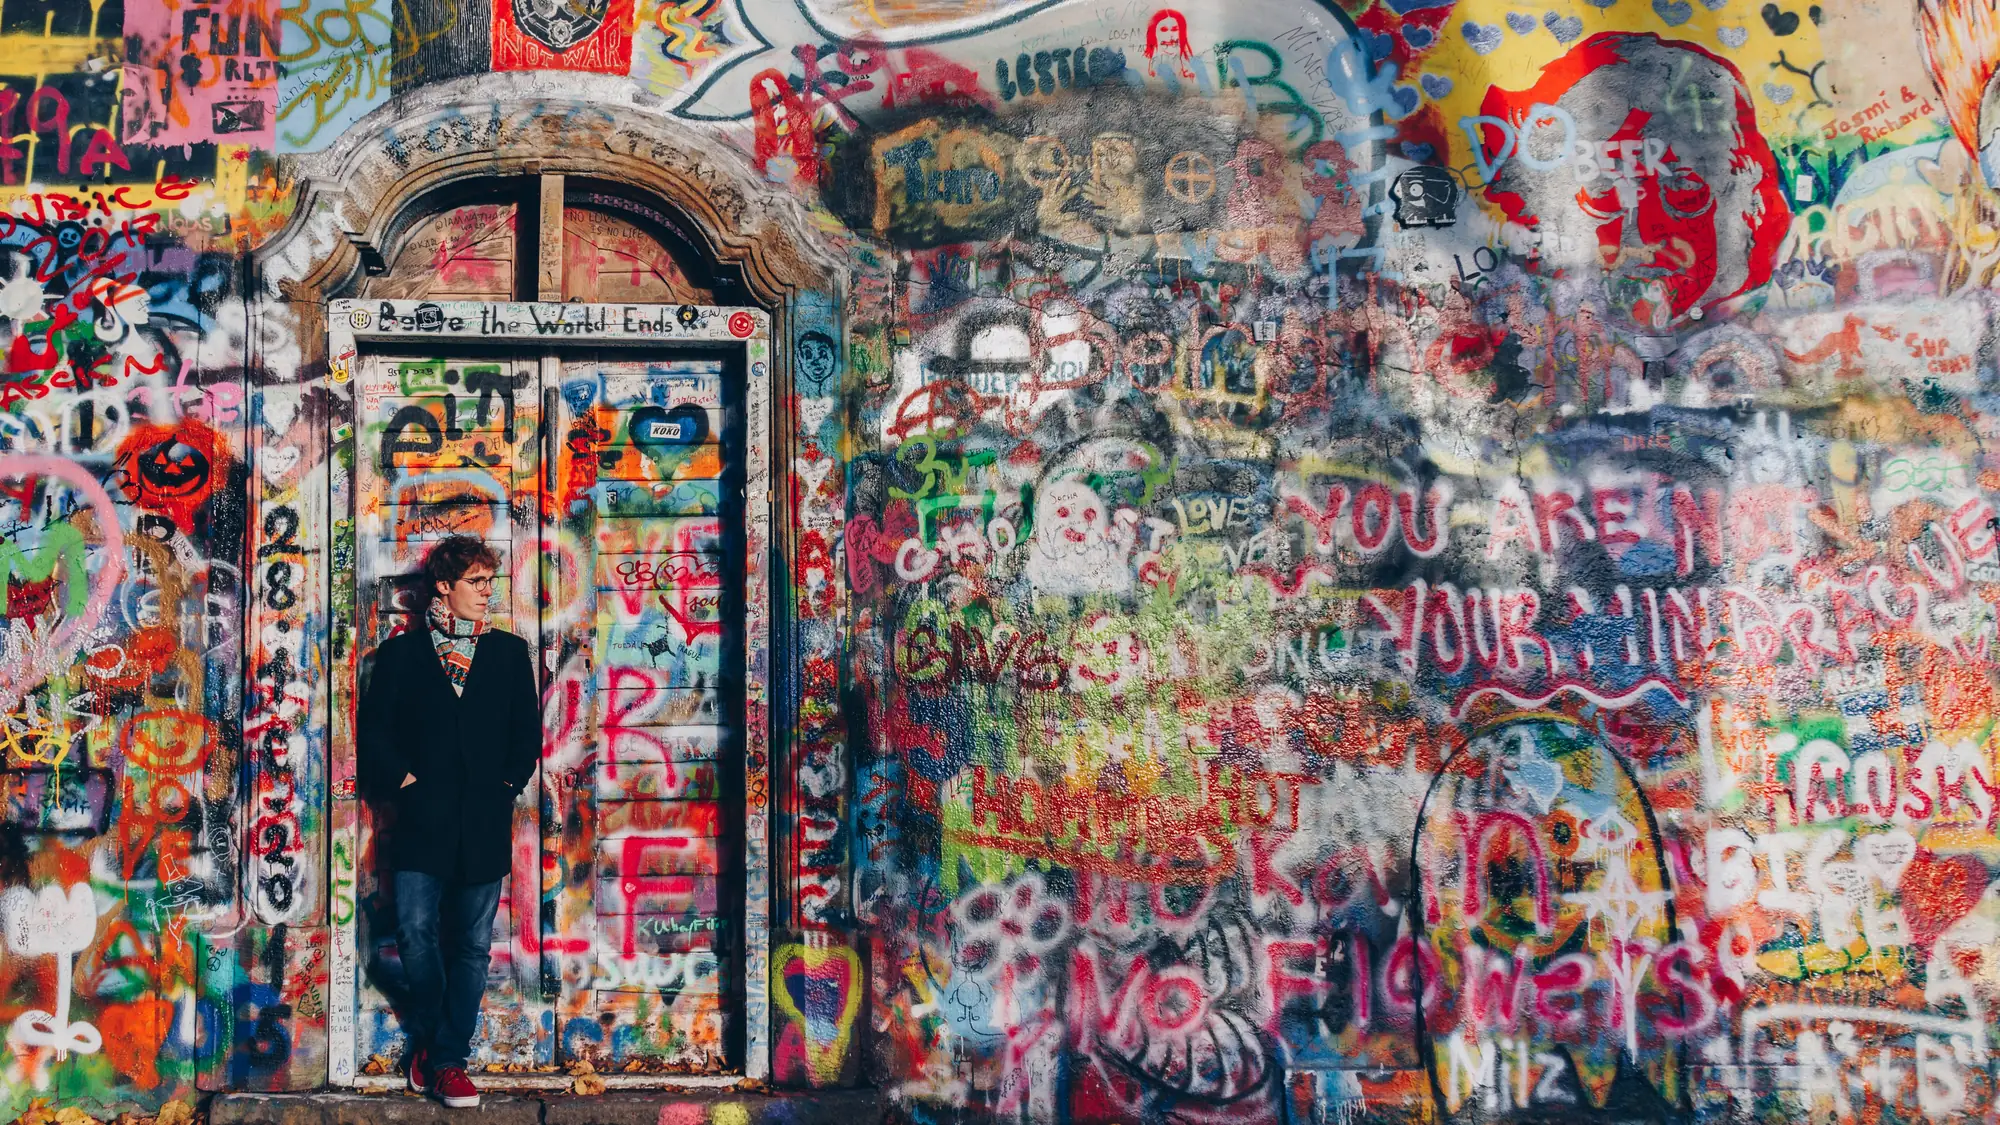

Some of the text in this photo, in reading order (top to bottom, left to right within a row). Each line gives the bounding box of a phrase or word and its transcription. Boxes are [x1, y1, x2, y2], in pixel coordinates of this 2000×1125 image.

[500, 15, 626, 67] NOT WAR
[1854, 95, 1936, 146] Richard
[1573, 138, 1673, 182] BEER
[569, 211, 618, 223] NO LOVE
[591, 225, 645, 239] IS NO LIFE
[481, 304, 521, 335] the
[623, 306, 673, 334] Ends
[652, 426, 680, 436] KOKO
[1170, 497, 1251, 535] LOVE
[1295, 484, 1450, 558] YOU
[1486, 480, 1648, 558] ARE
[1370, 578, 1562, 682] YOUR
[330, 1015, 352, 1025] FIND
[337, 1004, 352, 1013] WILL
